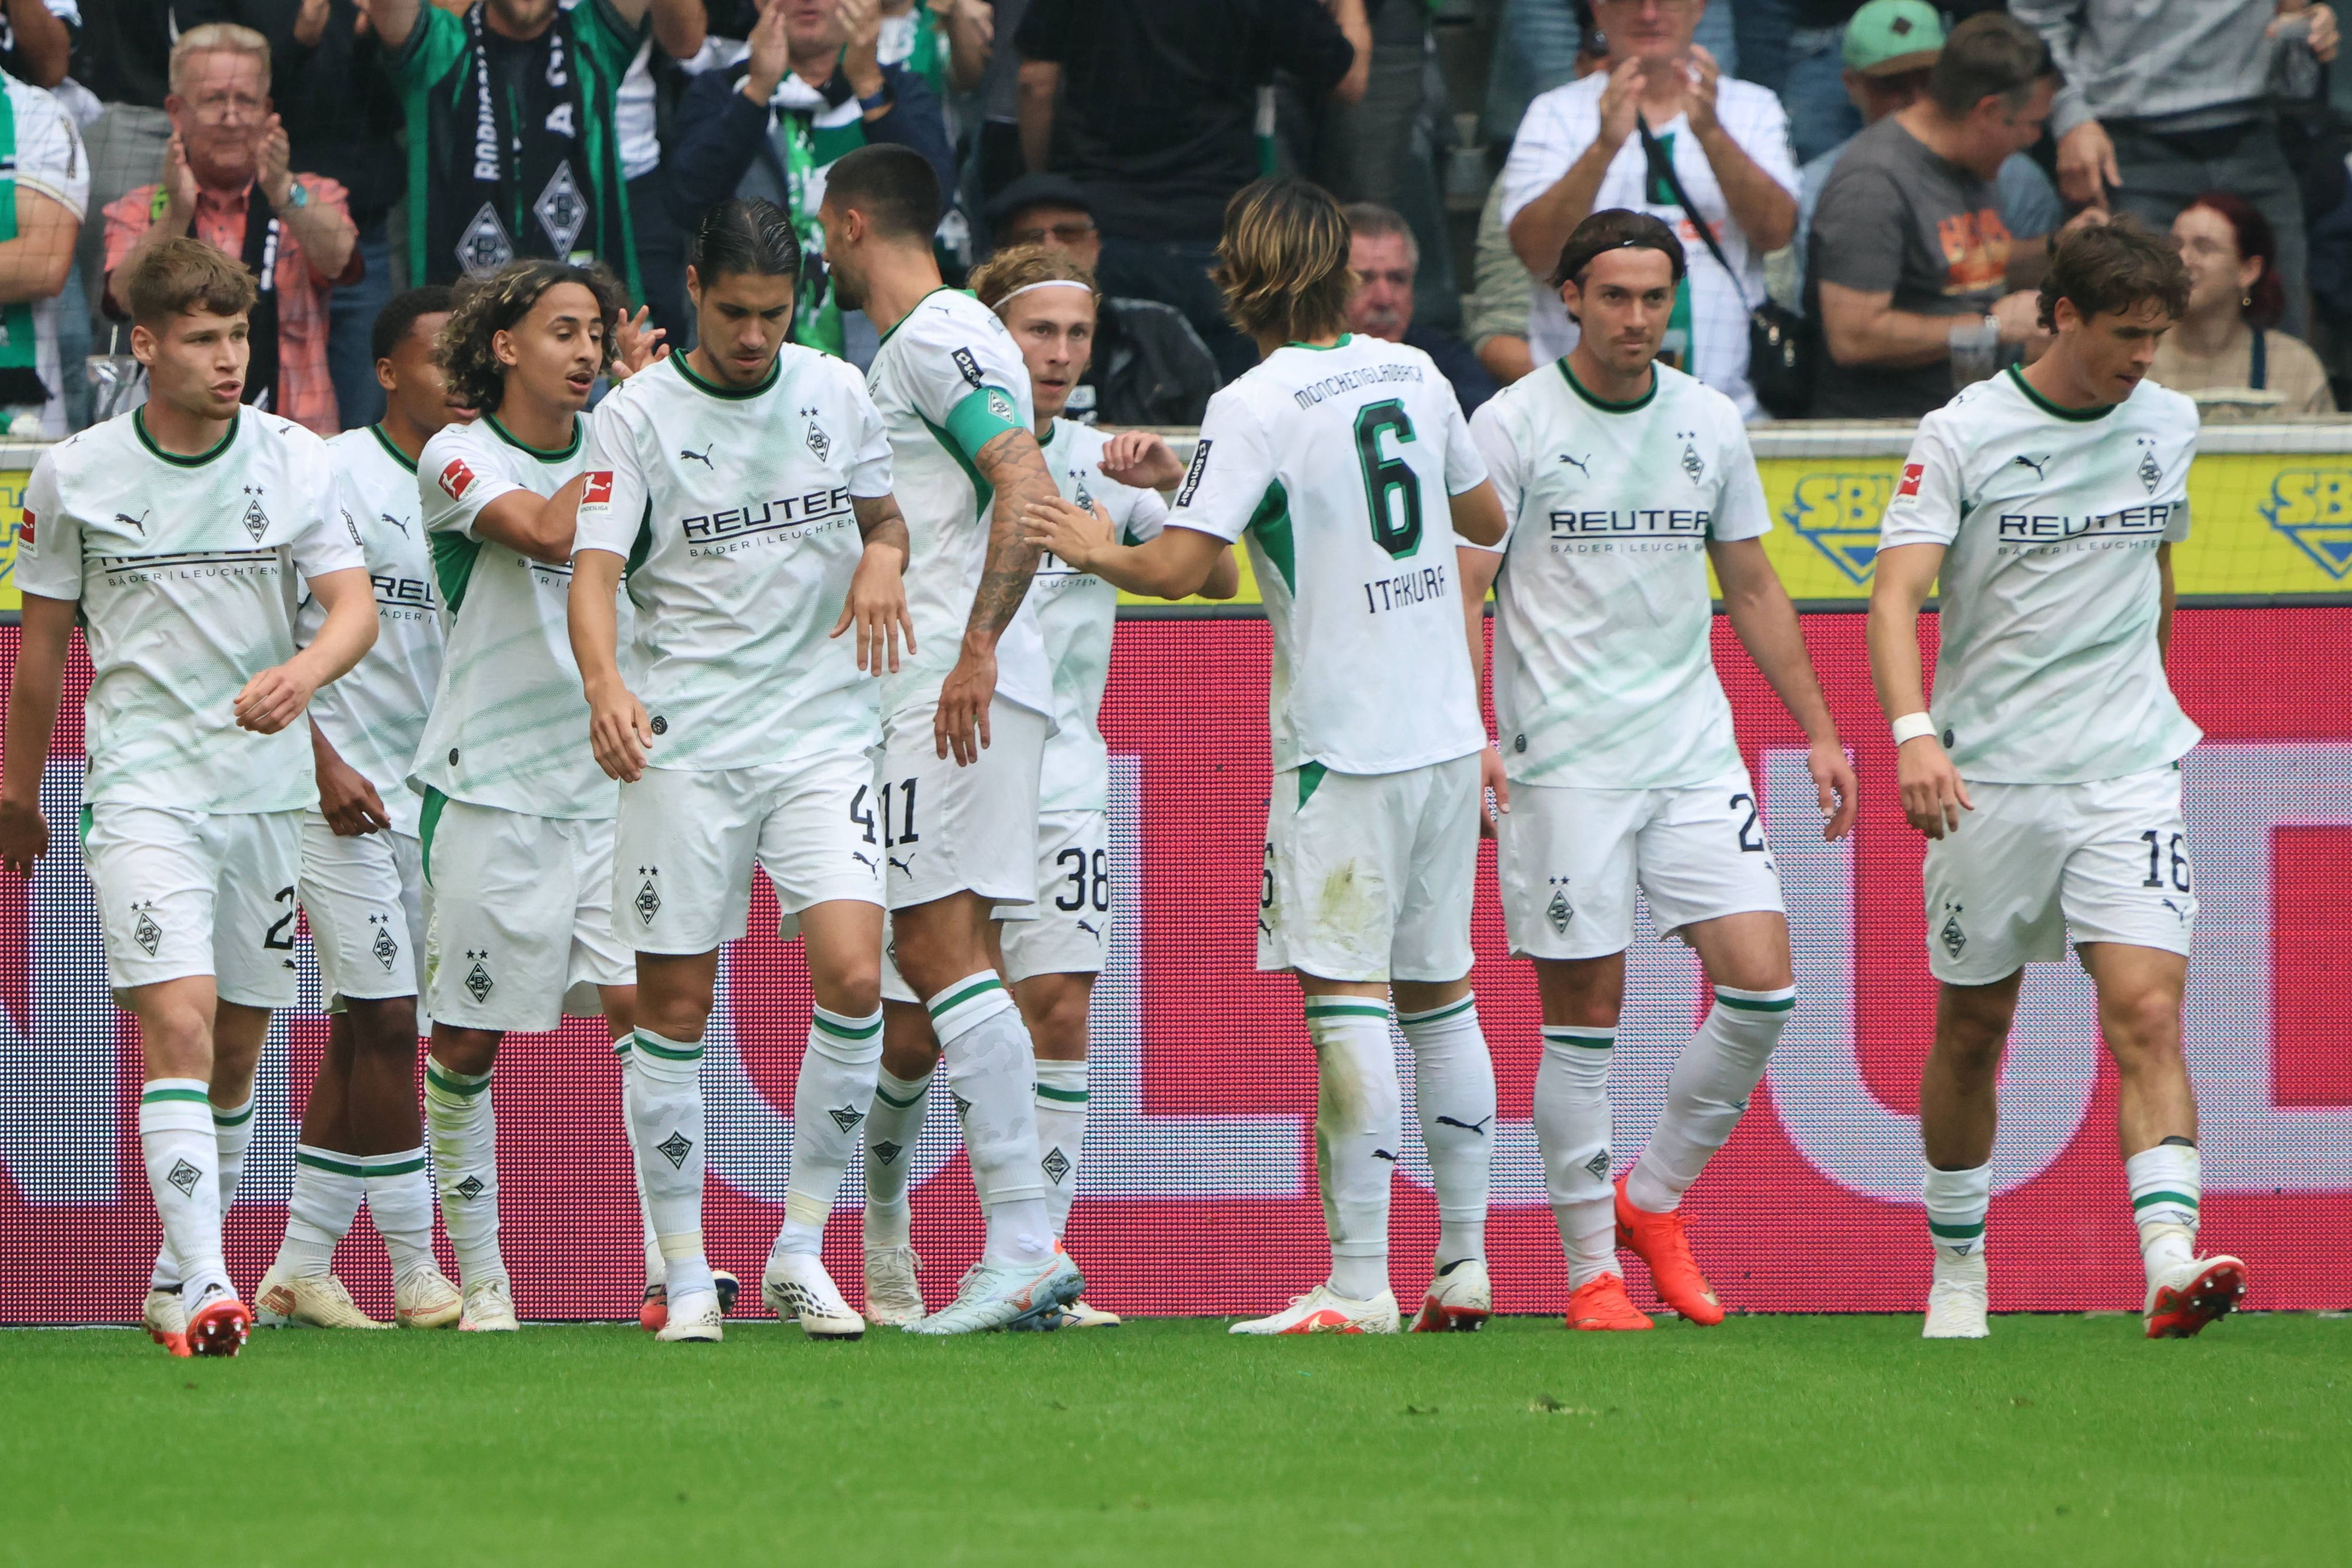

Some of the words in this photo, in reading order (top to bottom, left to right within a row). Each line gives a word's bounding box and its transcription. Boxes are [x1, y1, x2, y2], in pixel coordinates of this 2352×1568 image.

[1181, 458, 1204, 504] sonepar
[1352, 397, 1424, 560] 6
[682, 486, 851, 537] REUTER
[1550, 510, 1709, 532] REUTER
[1999, 504, 2170, 536] REUTER
[690, 540, 750, 557] BÄDER
[767, 518, 855, 544] LEUCHTEN
[2077, 539, 2158, 551] LEUCHTE
[108, 573, 162, 587] BÄDER
[181, 566, 278, 579] LEUCHTEN
[1039, 579, 1097, 588] EUCTEN
[380, 609, 422, 621] ÄDER
[850, 784, 877, 844] 4
[878, 777, 919, 848] 11
[1056, 848, 1109, 912] 38
[2141, 830, 2190, 893] 16
